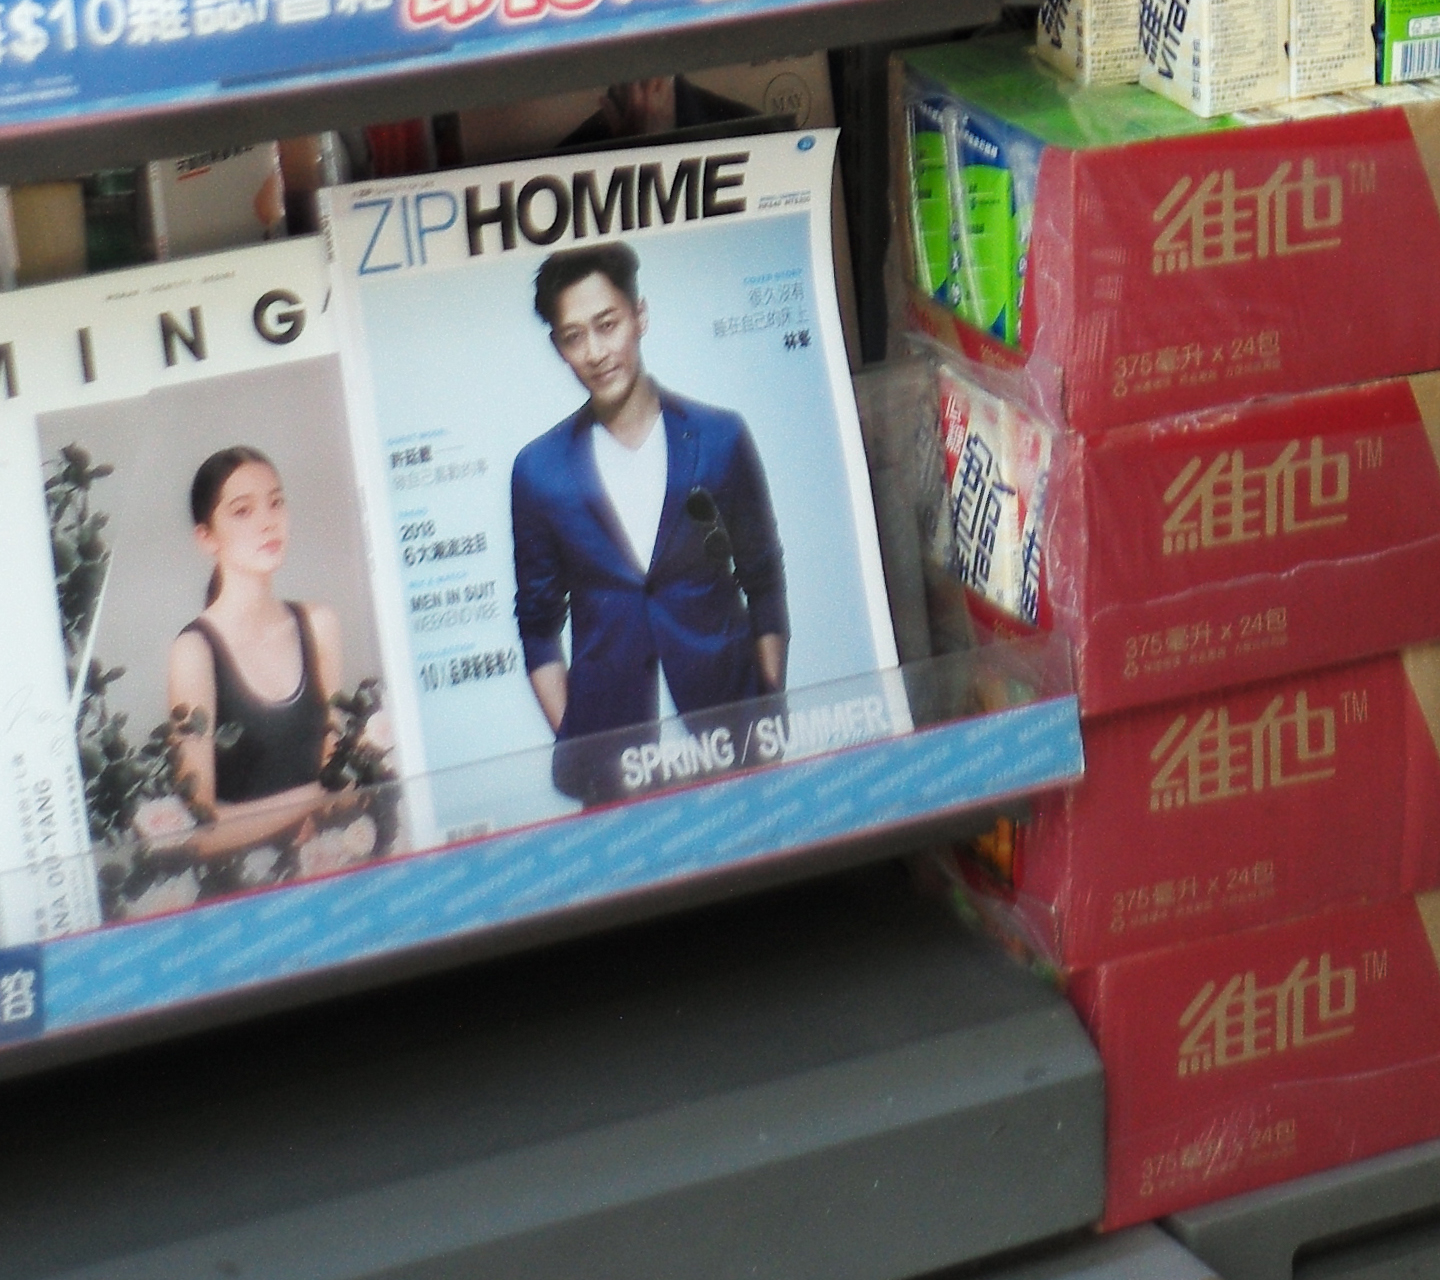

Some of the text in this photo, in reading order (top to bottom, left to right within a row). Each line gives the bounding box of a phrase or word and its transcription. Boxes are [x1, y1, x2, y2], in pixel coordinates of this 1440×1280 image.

[1152, 159, 1347, 273] 維他
[1161, 434, 1351, 556] 維他
[410, 589, 443, 613] MEN
[620, 694, 893, 789] SPRING SUMMER
[1148, 690, 1339, 814] 維他
[1176, 952, 1358, 1076] 維他
